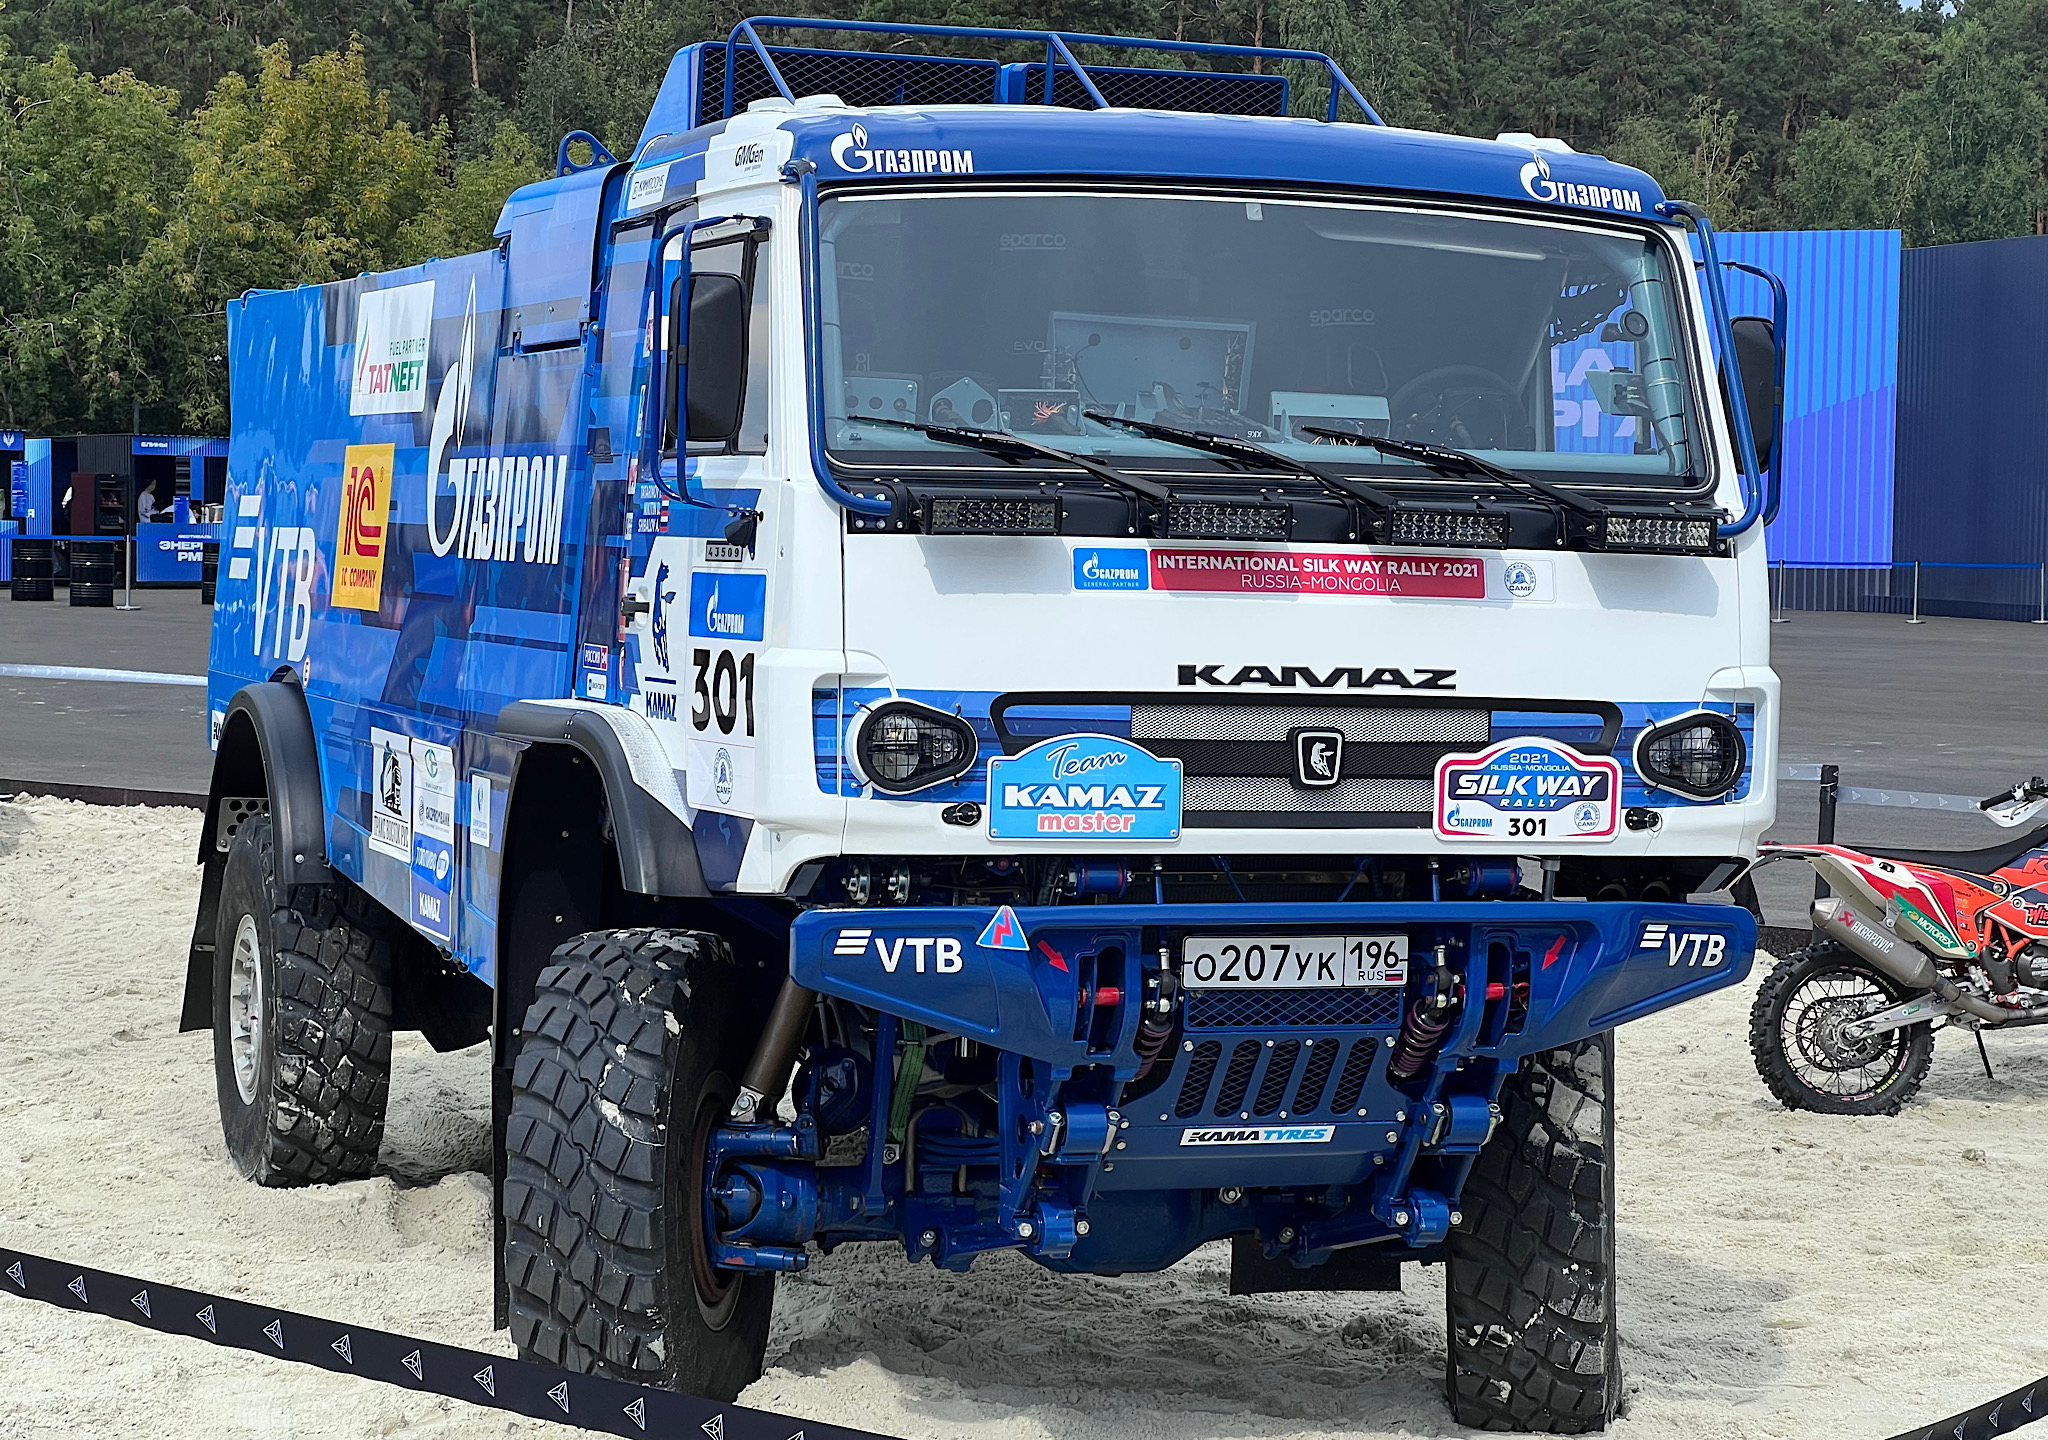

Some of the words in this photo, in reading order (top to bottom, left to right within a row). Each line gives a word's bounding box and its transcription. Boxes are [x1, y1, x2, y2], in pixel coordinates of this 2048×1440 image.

[874, 149, 975, 174] ГАЗПРОМ
[1556, 181, 1642, 213] ГАЗПРОМ
[1000, 232, 1066, 251] sparco
[1310, 308, 1375, 326] sparco
[368, 359, 424, 395] TATNEFT
[457, 455, 567, 565] ГАЗПРОМ
[349, 567, 378, 589] COMPANY
[1099, 568, 1139, 580] GAZPROM
[1157, 555, 1299, 573] INTERNATIONAL
[1302, 559, 1340, 573] SILK
[1343, 560, 1383, 575] WAY
[1387, 562, 1439, 577] RALLY
[1443, 564, 1478, 578] 2021
[253, 526, 316, 662] VTB
[716, 613, 744, 635] GAZPROM
[1177, 664, 1457, 691] KAMAZ
[691, 648, 755, 737] 301
[645, 690, 677, 722] KAMAZ
[1047, 742, 1126, 779] Team
[1490, 764, 1571, 772] RUSSIA-MONGOLIA
[1509, 753, 1549, 764] 2021
[1003, 784, 1165, 808] KAMAZ
[1454, 774, 1534, 797] SILK
[1535, 774, 1603, 797] WAY
[1499, 798, 1559, 808] RALLY
[1037, 812, 1135, 832] master
[1460, 817, 1493, 828] GAZPROM
[1508, 817, 1547, 837] 301
[419, 891, 441, 923] KAMAZ
[1916, 917, 1955, 948] MOTOREX
[874, 937, 964, 974] VTB
[1349, 940, 1400, 970] 196
[1668, 932, 1726, 967] VTB
[1357, 969, 1384, 981] RUS
